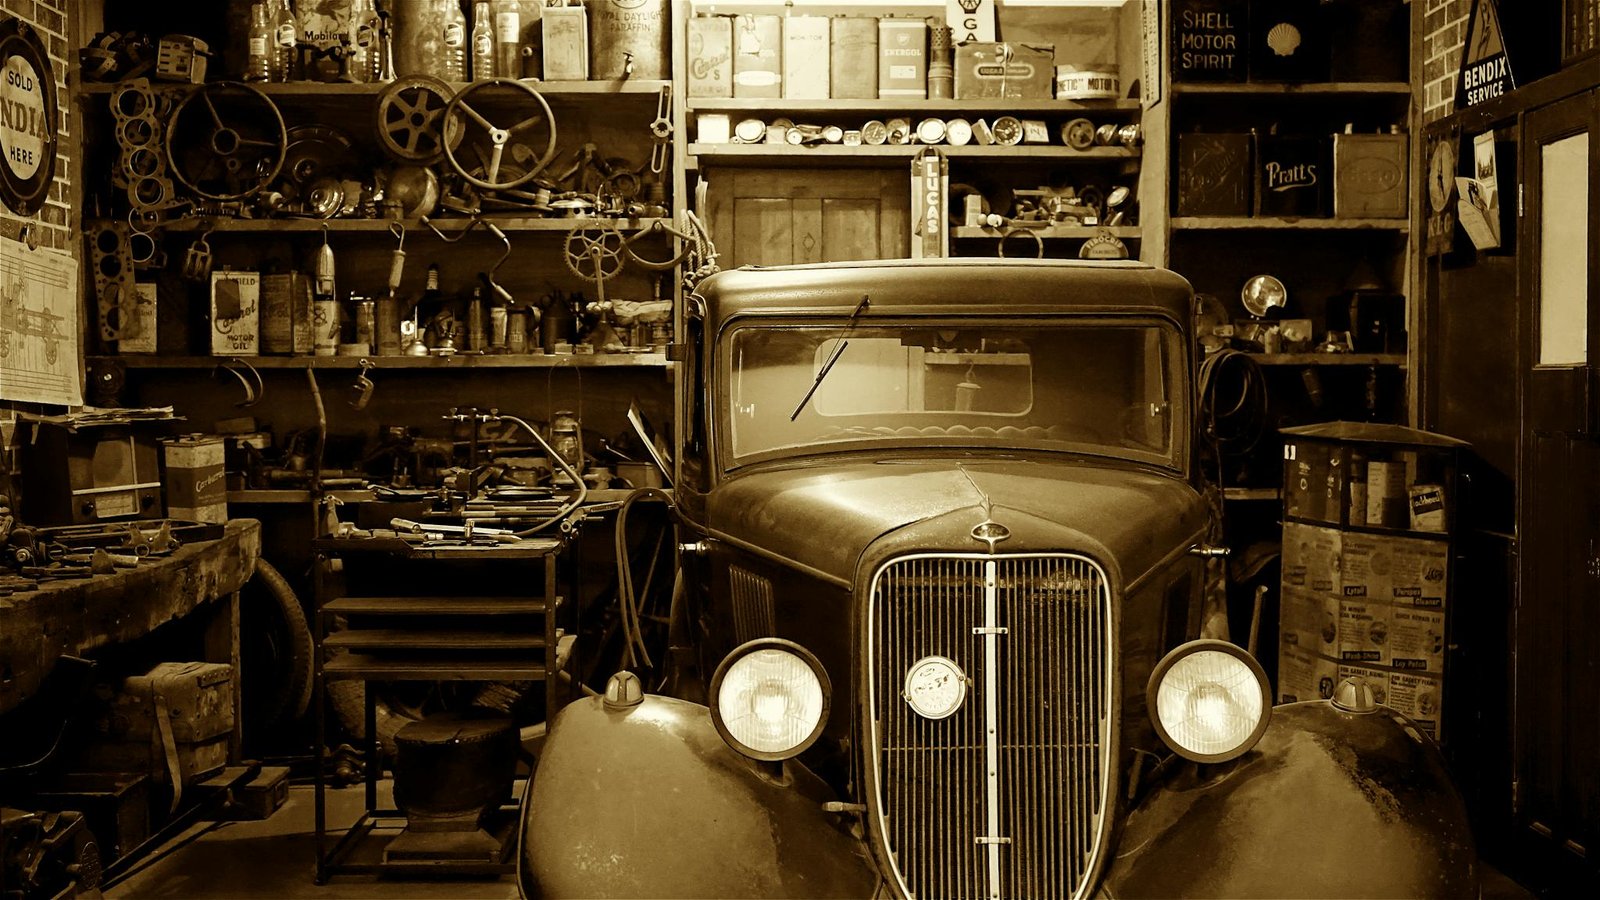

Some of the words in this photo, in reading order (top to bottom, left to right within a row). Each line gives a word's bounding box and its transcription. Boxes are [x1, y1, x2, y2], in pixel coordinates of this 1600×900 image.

[610, 22, 650, 32] PARAFFIN
[1183, 10, 1234, 29] SHELL
[1181, 33, 1236, 49] MOTOR
[1182, 52, 1236, 69] SPIRIT
[8, 70, 33, 92] SOLD
[1464, 56, 1507, 90] BENDIX
[1087, 78, 1113, 92] MOTOR
[1467, 81, 1504, 106] SERVICE
[10, 145, 33, 165] HERE
[1265, 161, 1317, 192] Pratts
[926, 162, 940, 234] LUCAS
[227, 333, 255, 343] MOTOR
[232, 342, 249, 350] OIL
